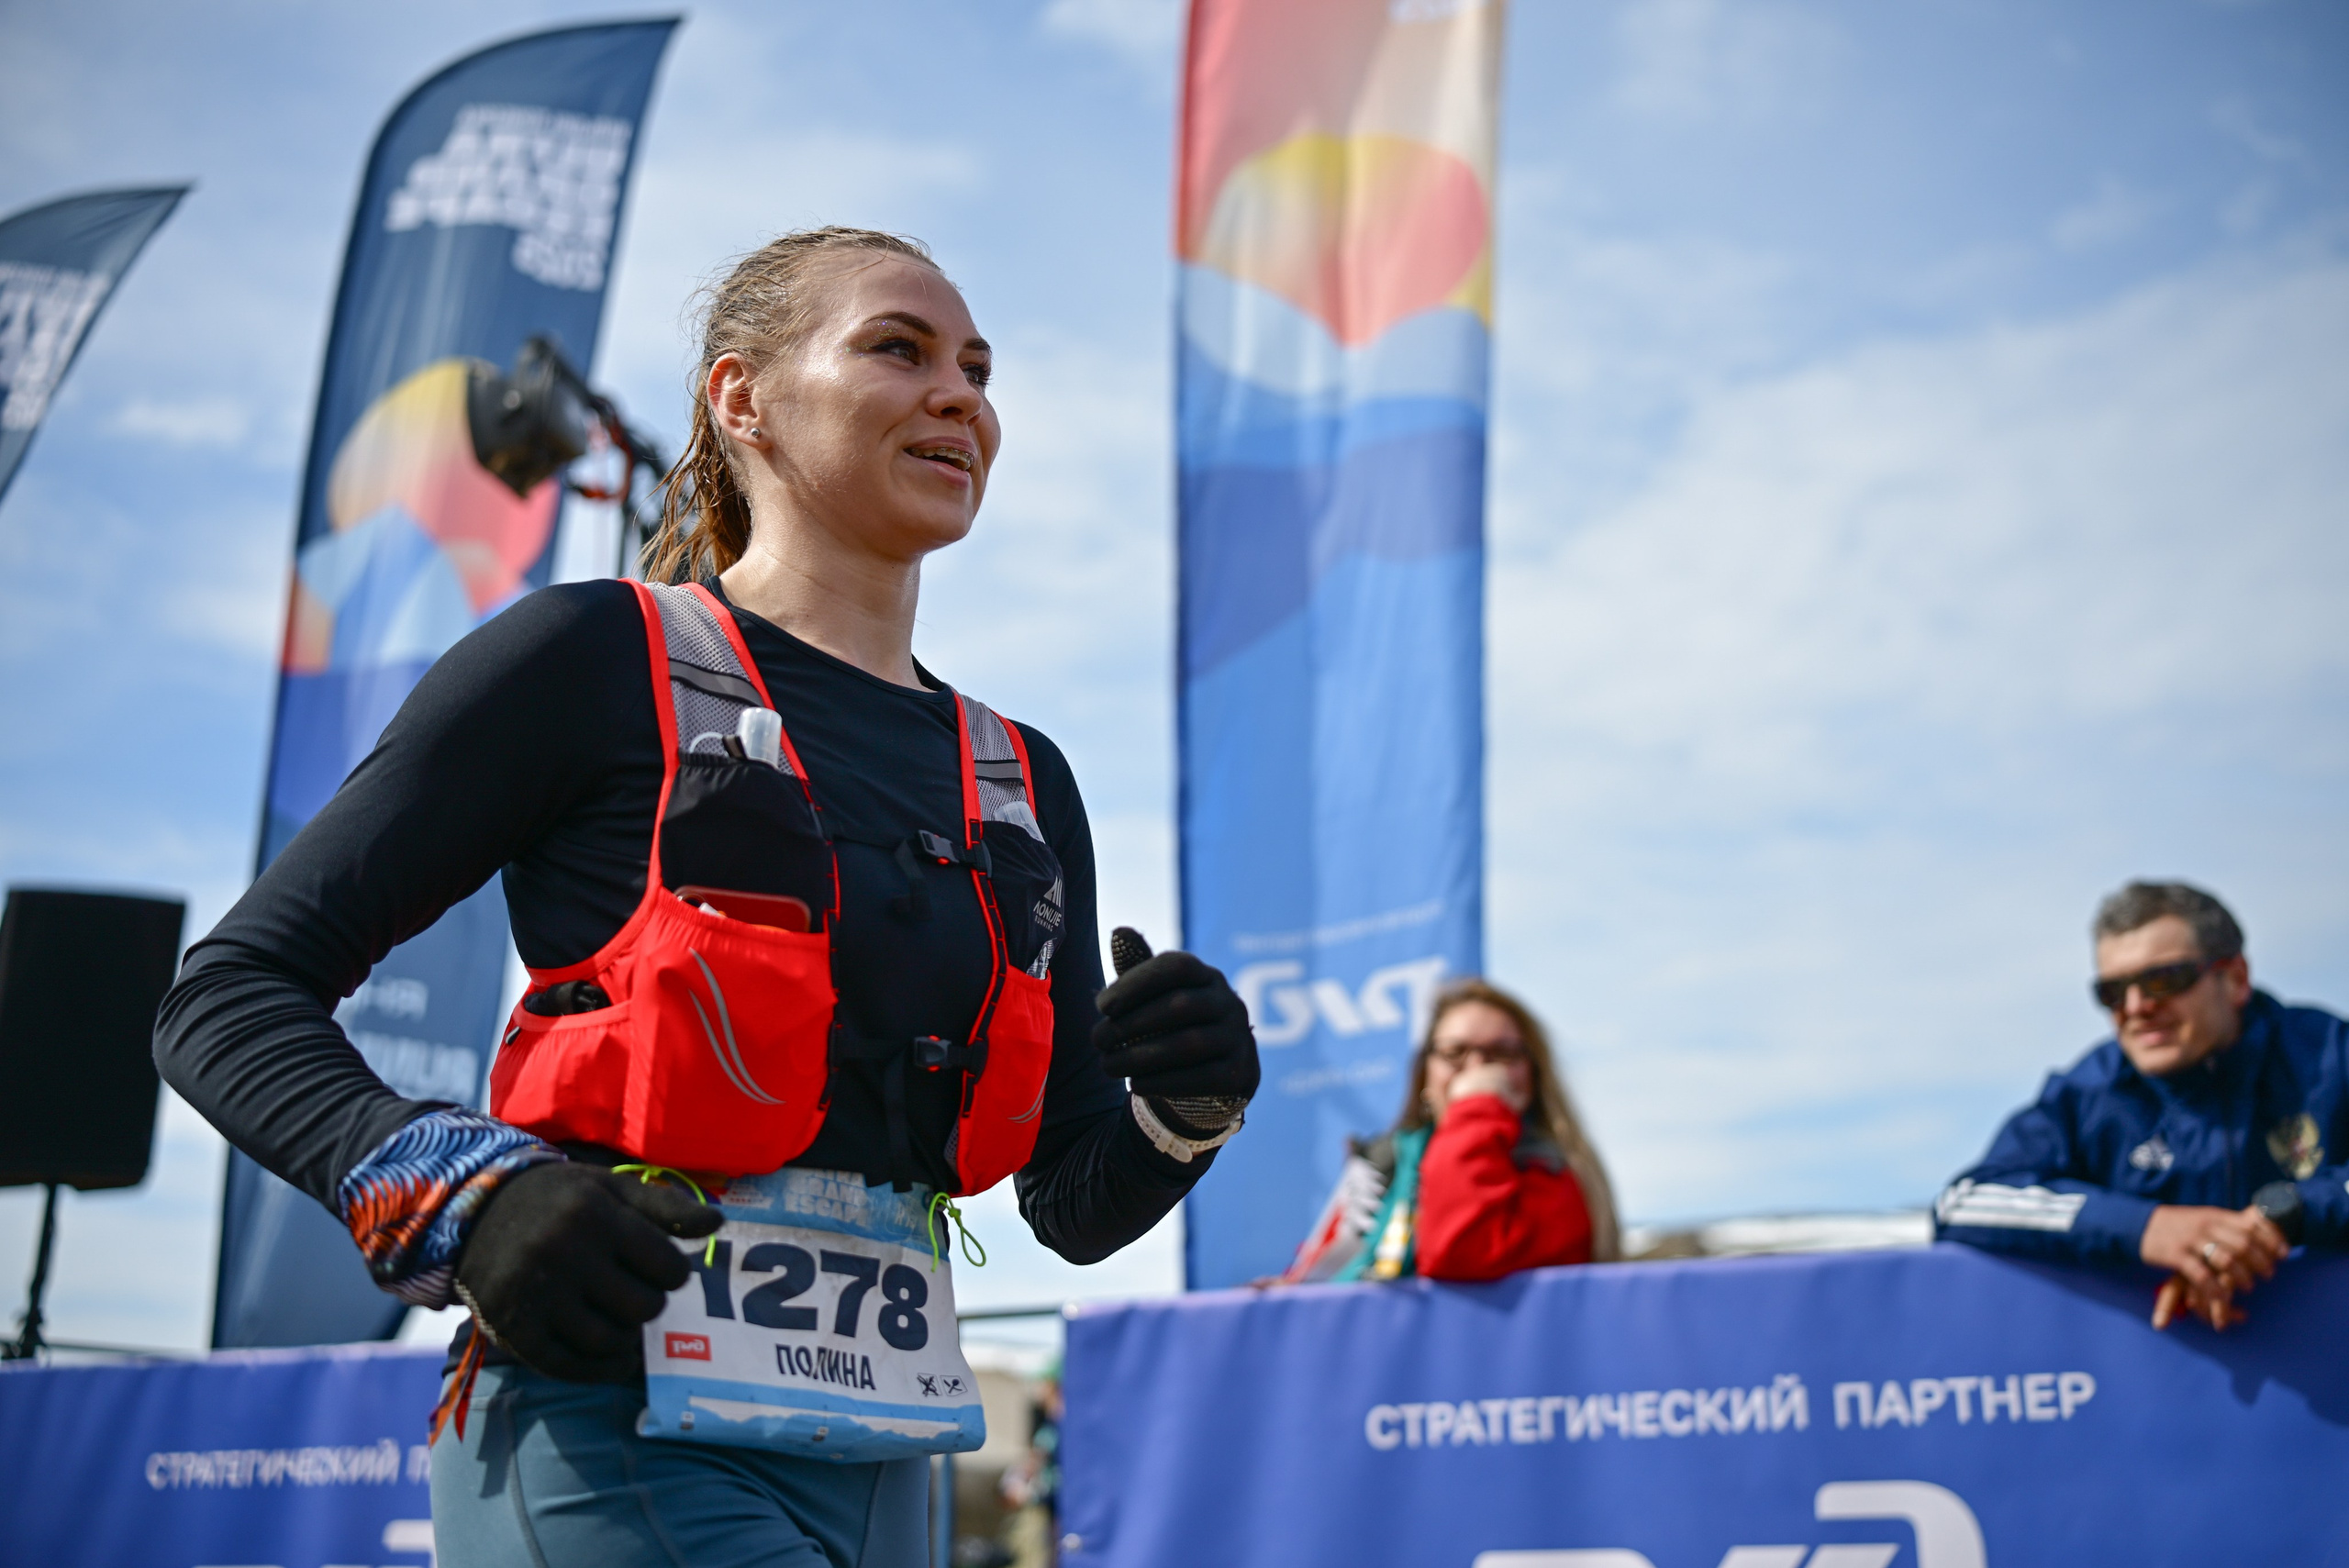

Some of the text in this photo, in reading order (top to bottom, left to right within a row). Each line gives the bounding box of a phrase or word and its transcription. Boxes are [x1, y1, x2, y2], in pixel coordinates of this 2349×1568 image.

[690, 1240, 929, 1351] 1278
[775, 1343, 876, 1391] ПОЛИНА
[1364, 1371, 2097, 1451] СТРАТЕГИЧЕСКИЙ ПАРТНЕР
